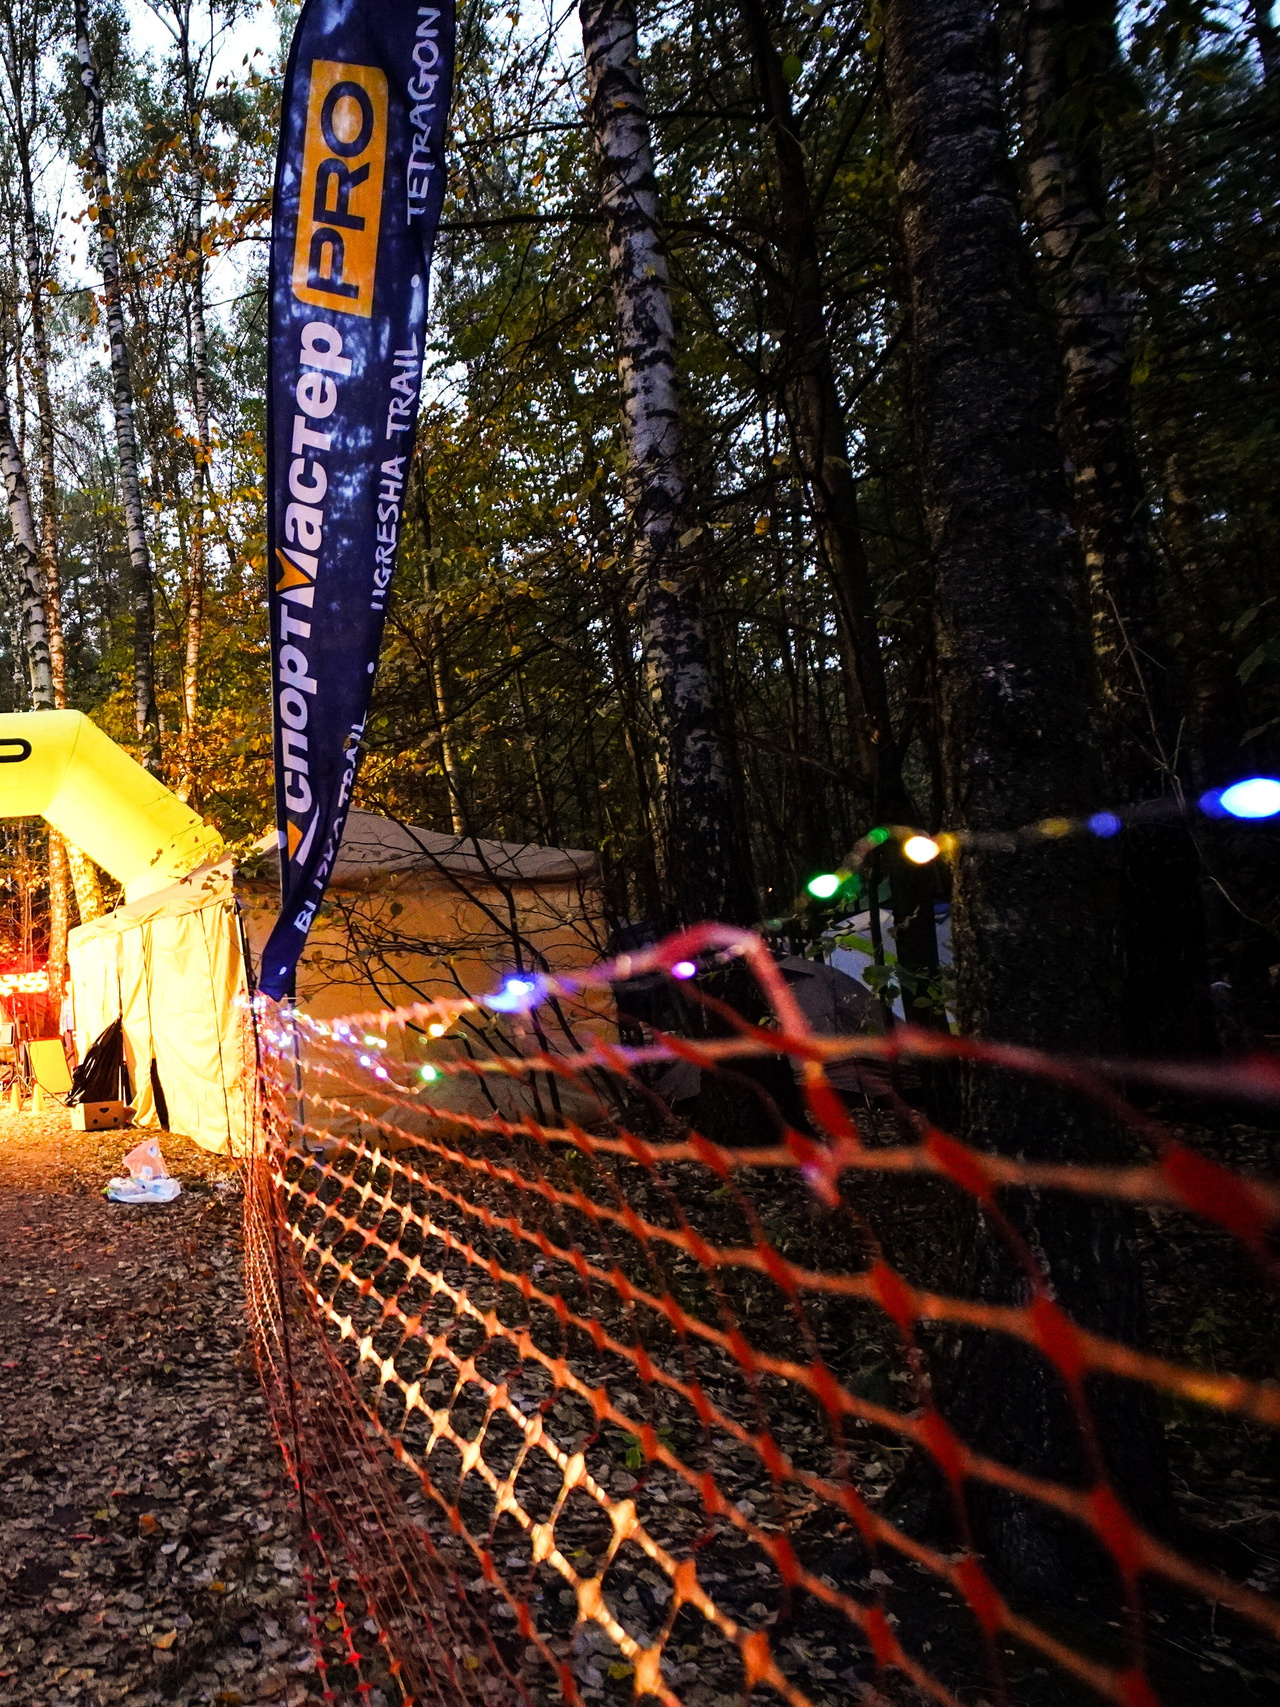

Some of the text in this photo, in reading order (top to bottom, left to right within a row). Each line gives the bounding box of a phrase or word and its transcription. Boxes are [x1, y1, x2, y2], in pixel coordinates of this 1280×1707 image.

[306, 80, 374, 299] PRO
[386, 332, 419, 440] TRAIL
[407, 7, 441, 225] TETRAGON
